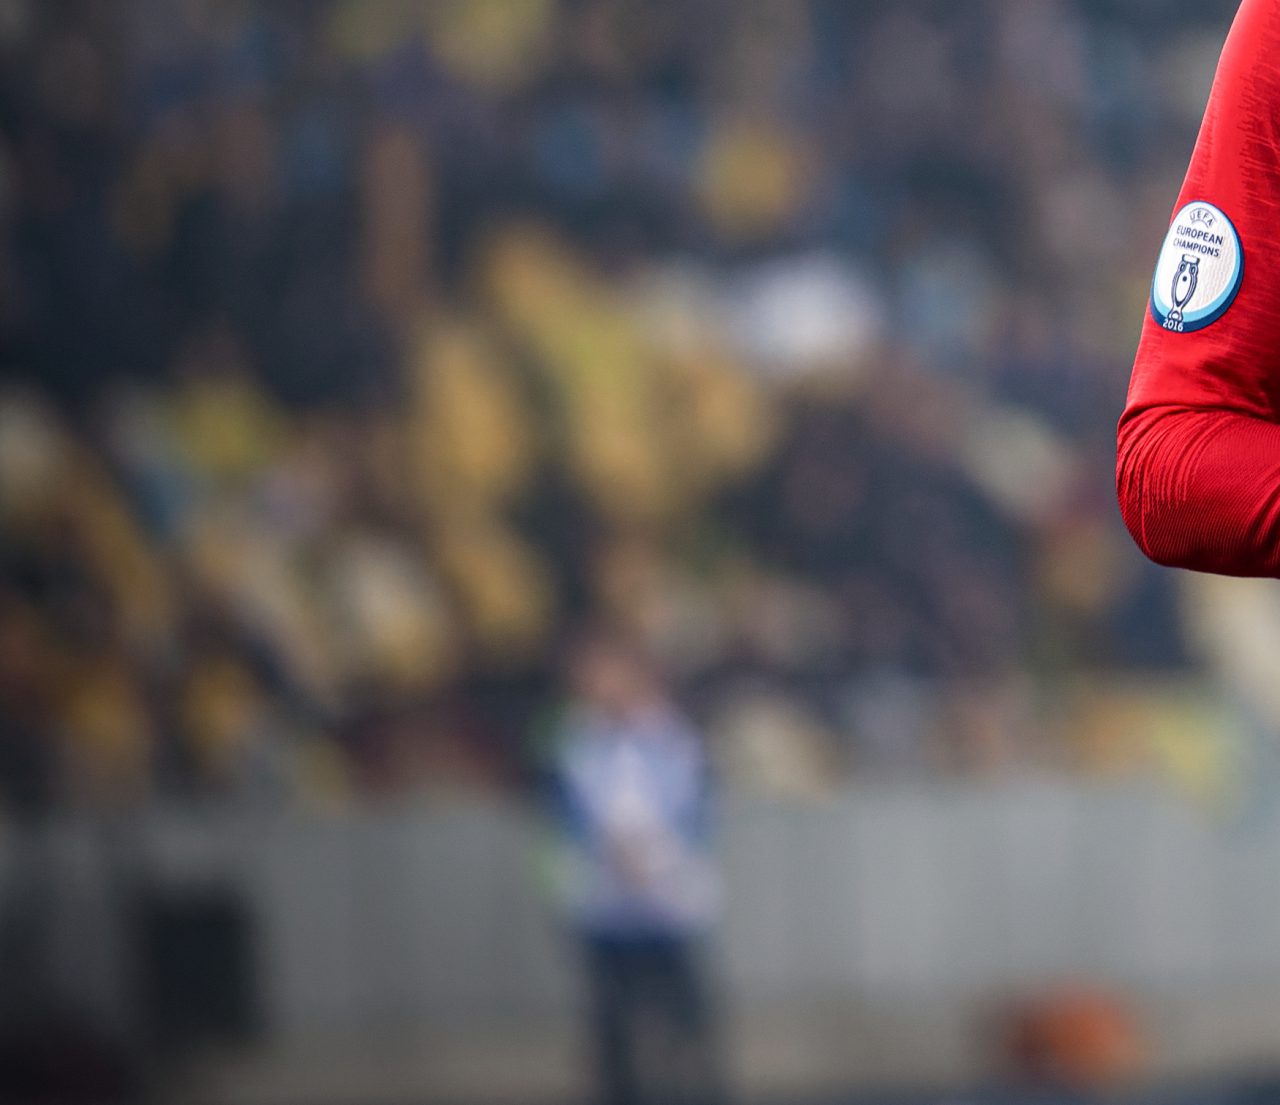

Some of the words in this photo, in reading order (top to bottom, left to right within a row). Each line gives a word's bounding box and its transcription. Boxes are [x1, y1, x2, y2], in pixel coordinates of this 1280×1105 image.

[1189, 210, 1213, 226] UEFA
[1176, 225, 1223, 245] EUROPEAN
[1173, 238, 1220, 257] CHAMPIONS
[1162, 319, 1184, 332] 2016
